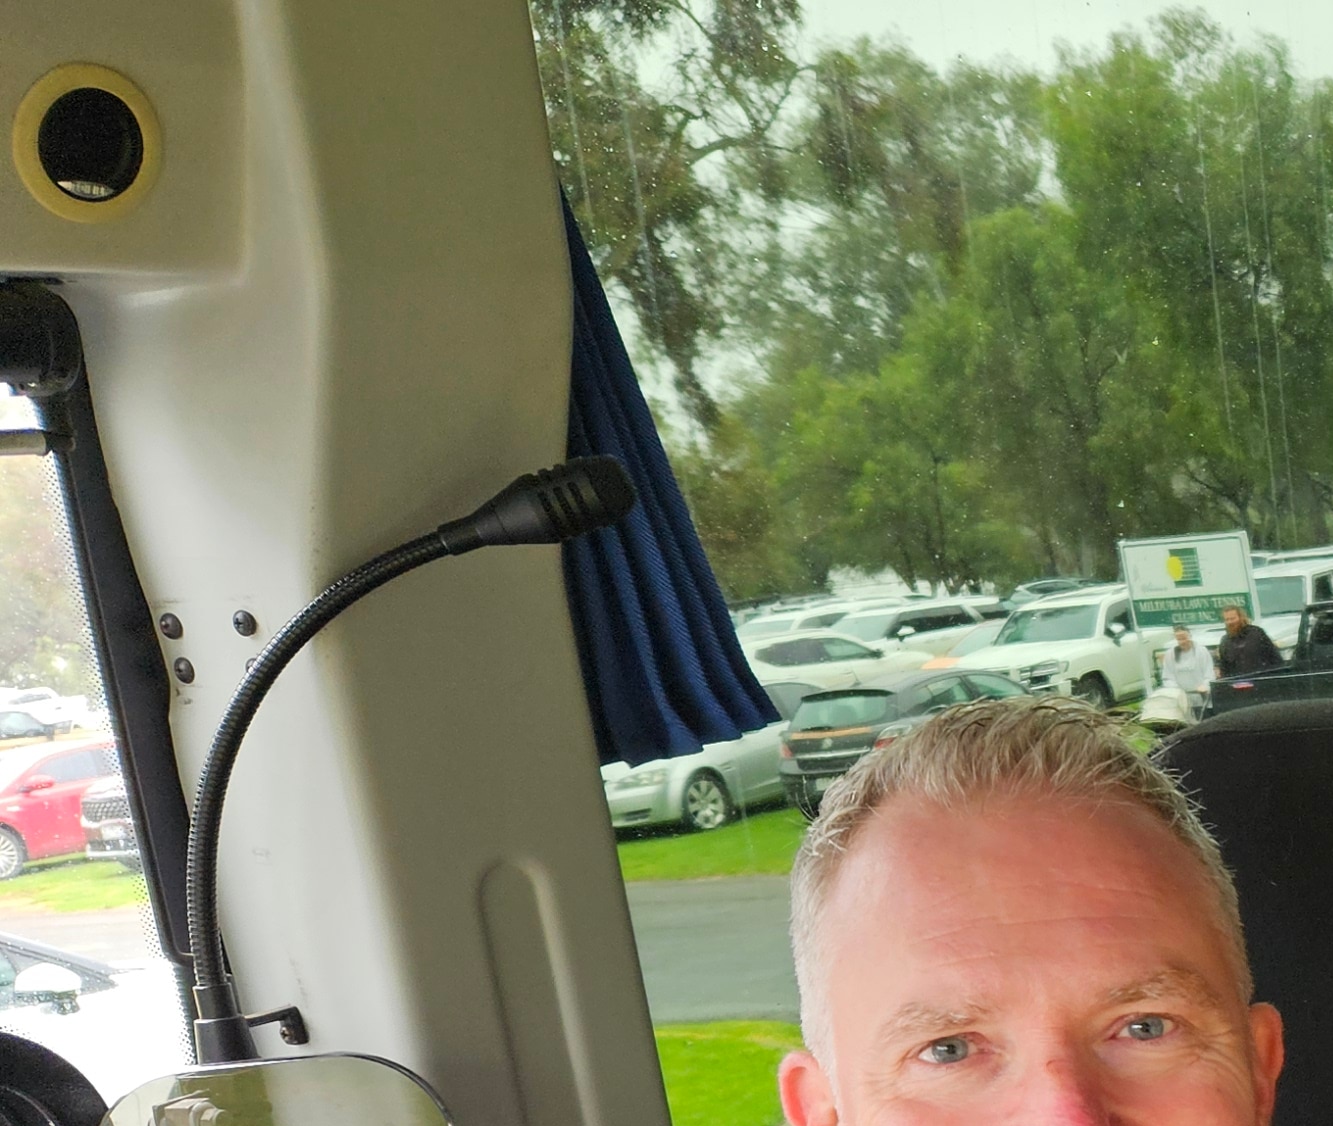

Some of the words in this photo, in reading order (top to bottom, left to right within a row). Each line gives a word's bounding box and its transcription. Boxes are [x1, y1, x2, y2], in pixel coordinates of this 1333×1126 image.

[1138, 598, 1182, 612] MILDURA
[1183, 597, 1210, 610] LAWN
[1211, 595, 1246, 608] TENNIS
